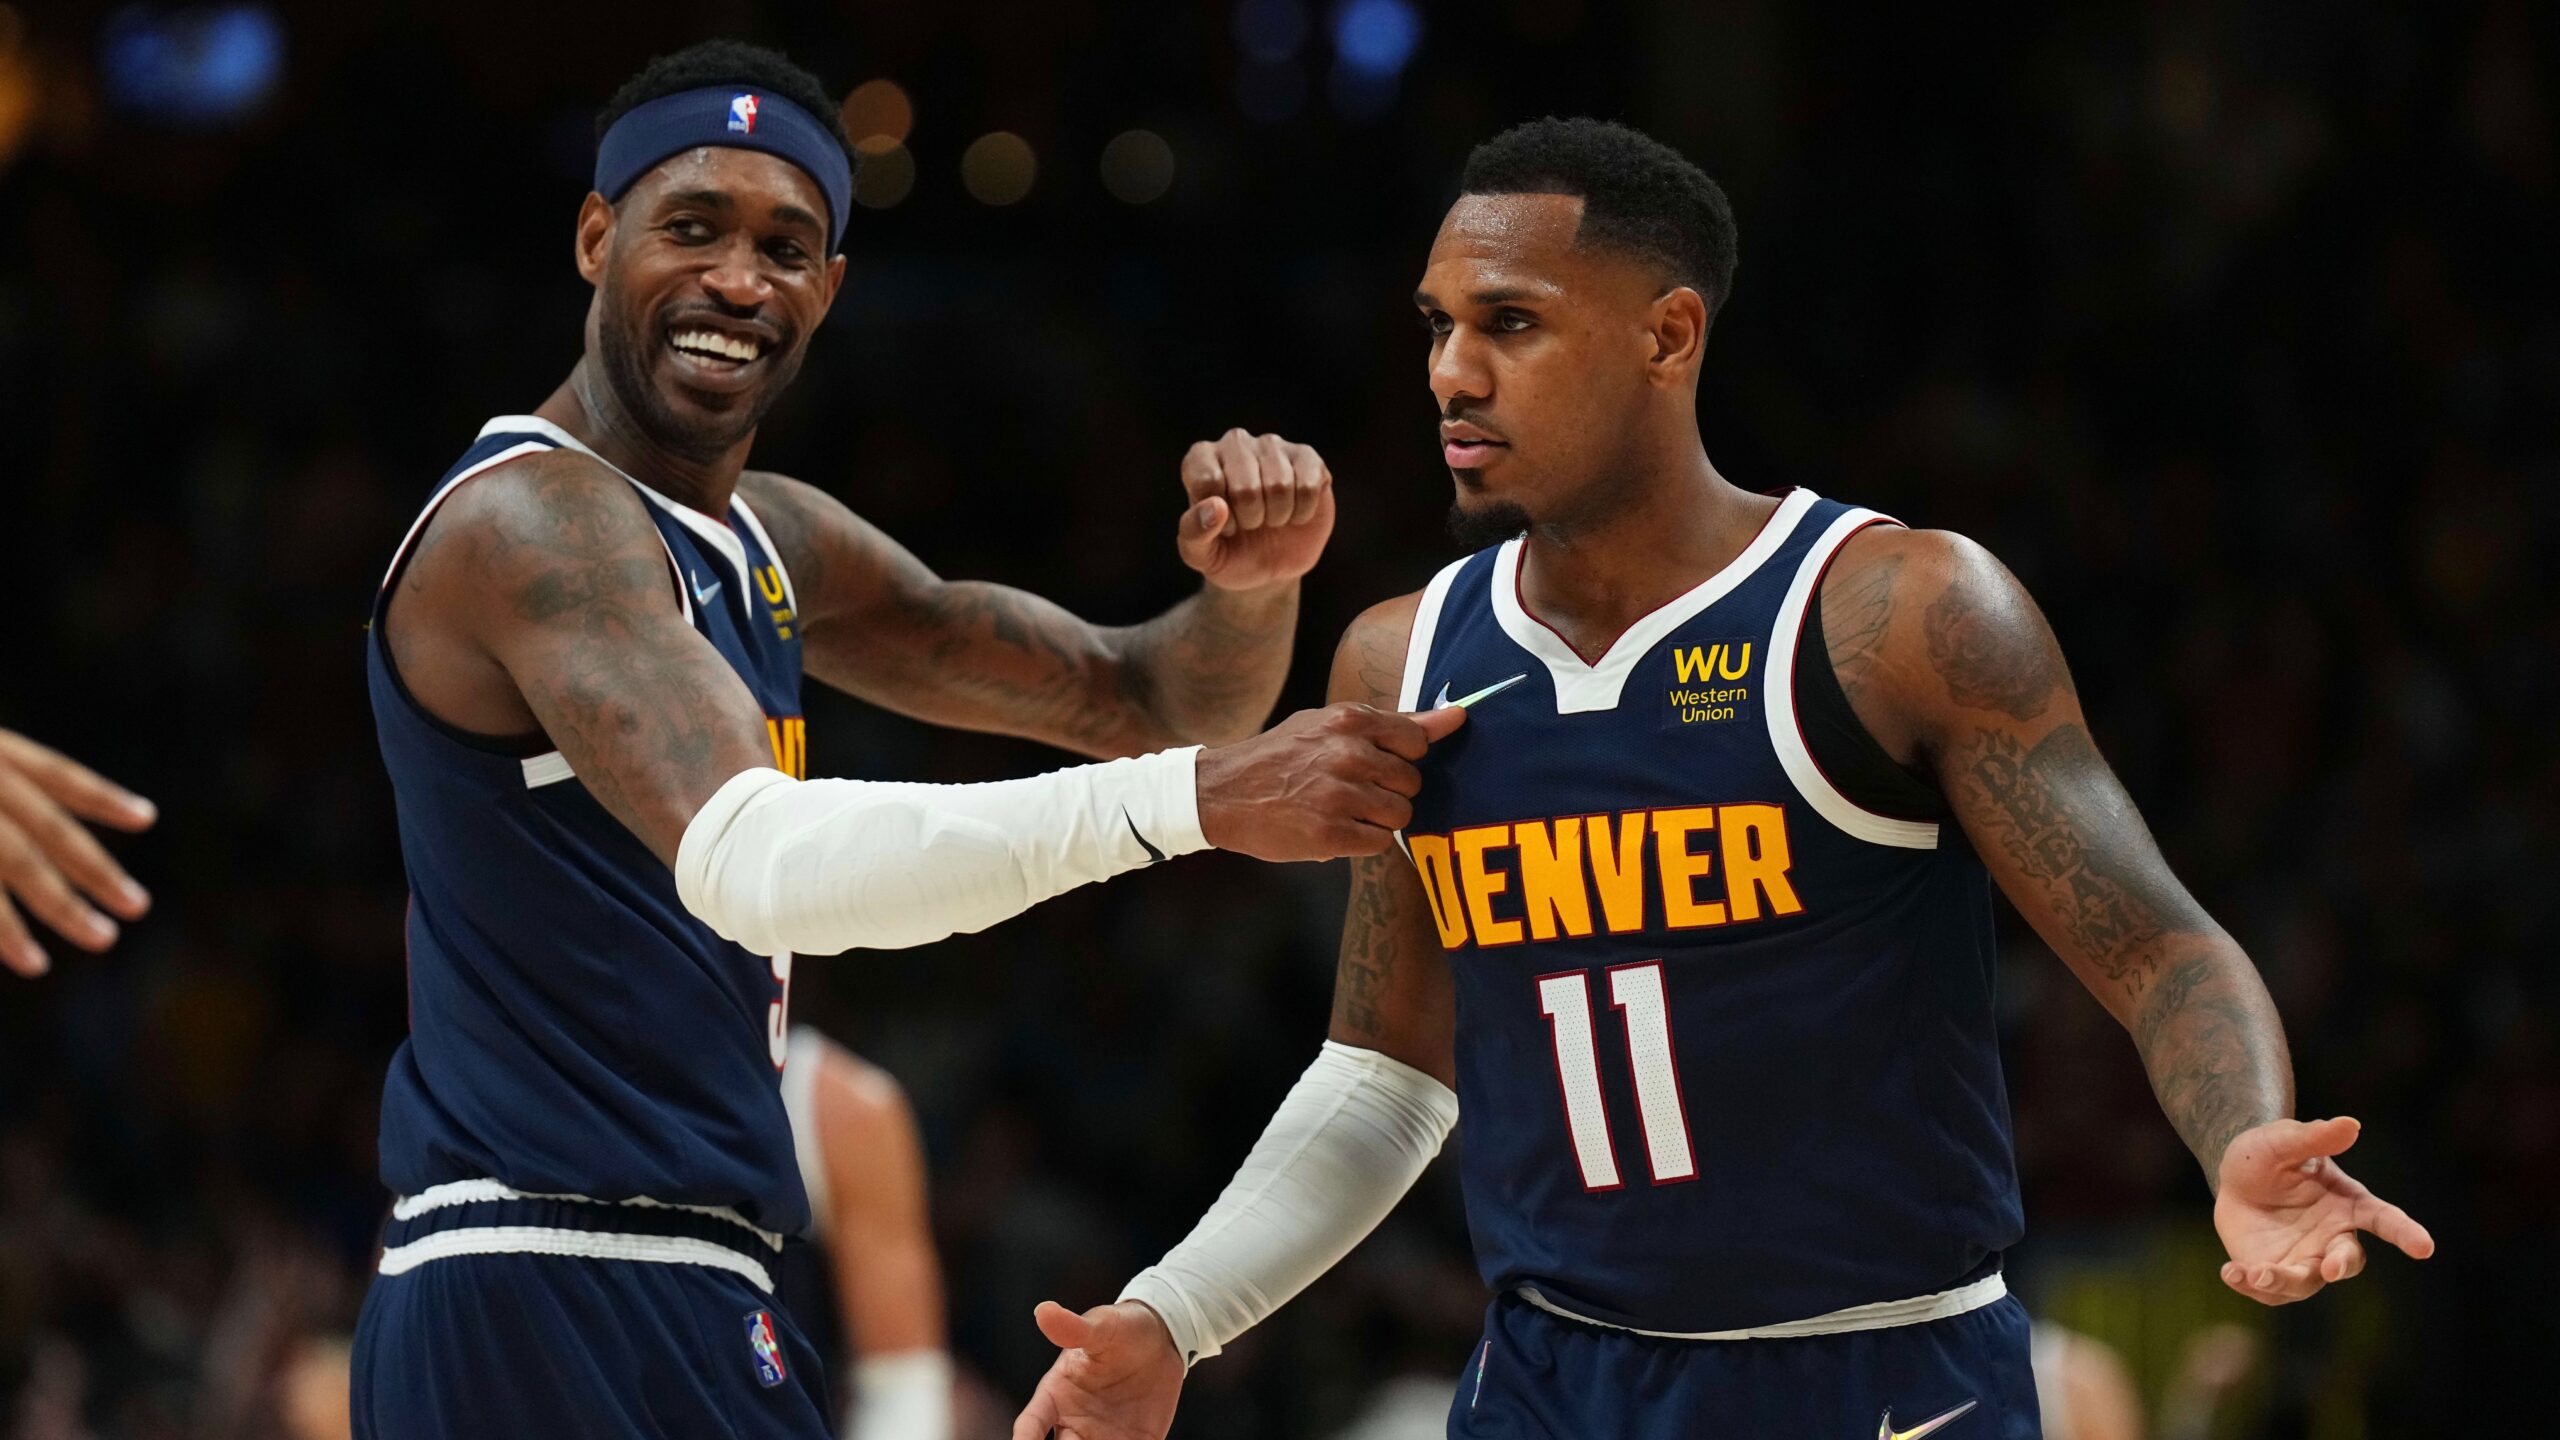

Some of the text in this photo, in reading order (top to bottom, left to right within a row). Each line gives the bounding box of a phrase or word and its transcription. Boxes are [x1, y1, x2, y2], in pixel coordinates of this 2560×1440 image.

[753, 564, 785, 605] U
[1674, 643, 1751, 684] WU
[1670, 688, 1747, 706] Western
[1682, 705, 1734, 723] Union
[1408, 801, 1807, 951] DENVER
[1534, 959, 1701, 1194] 11
